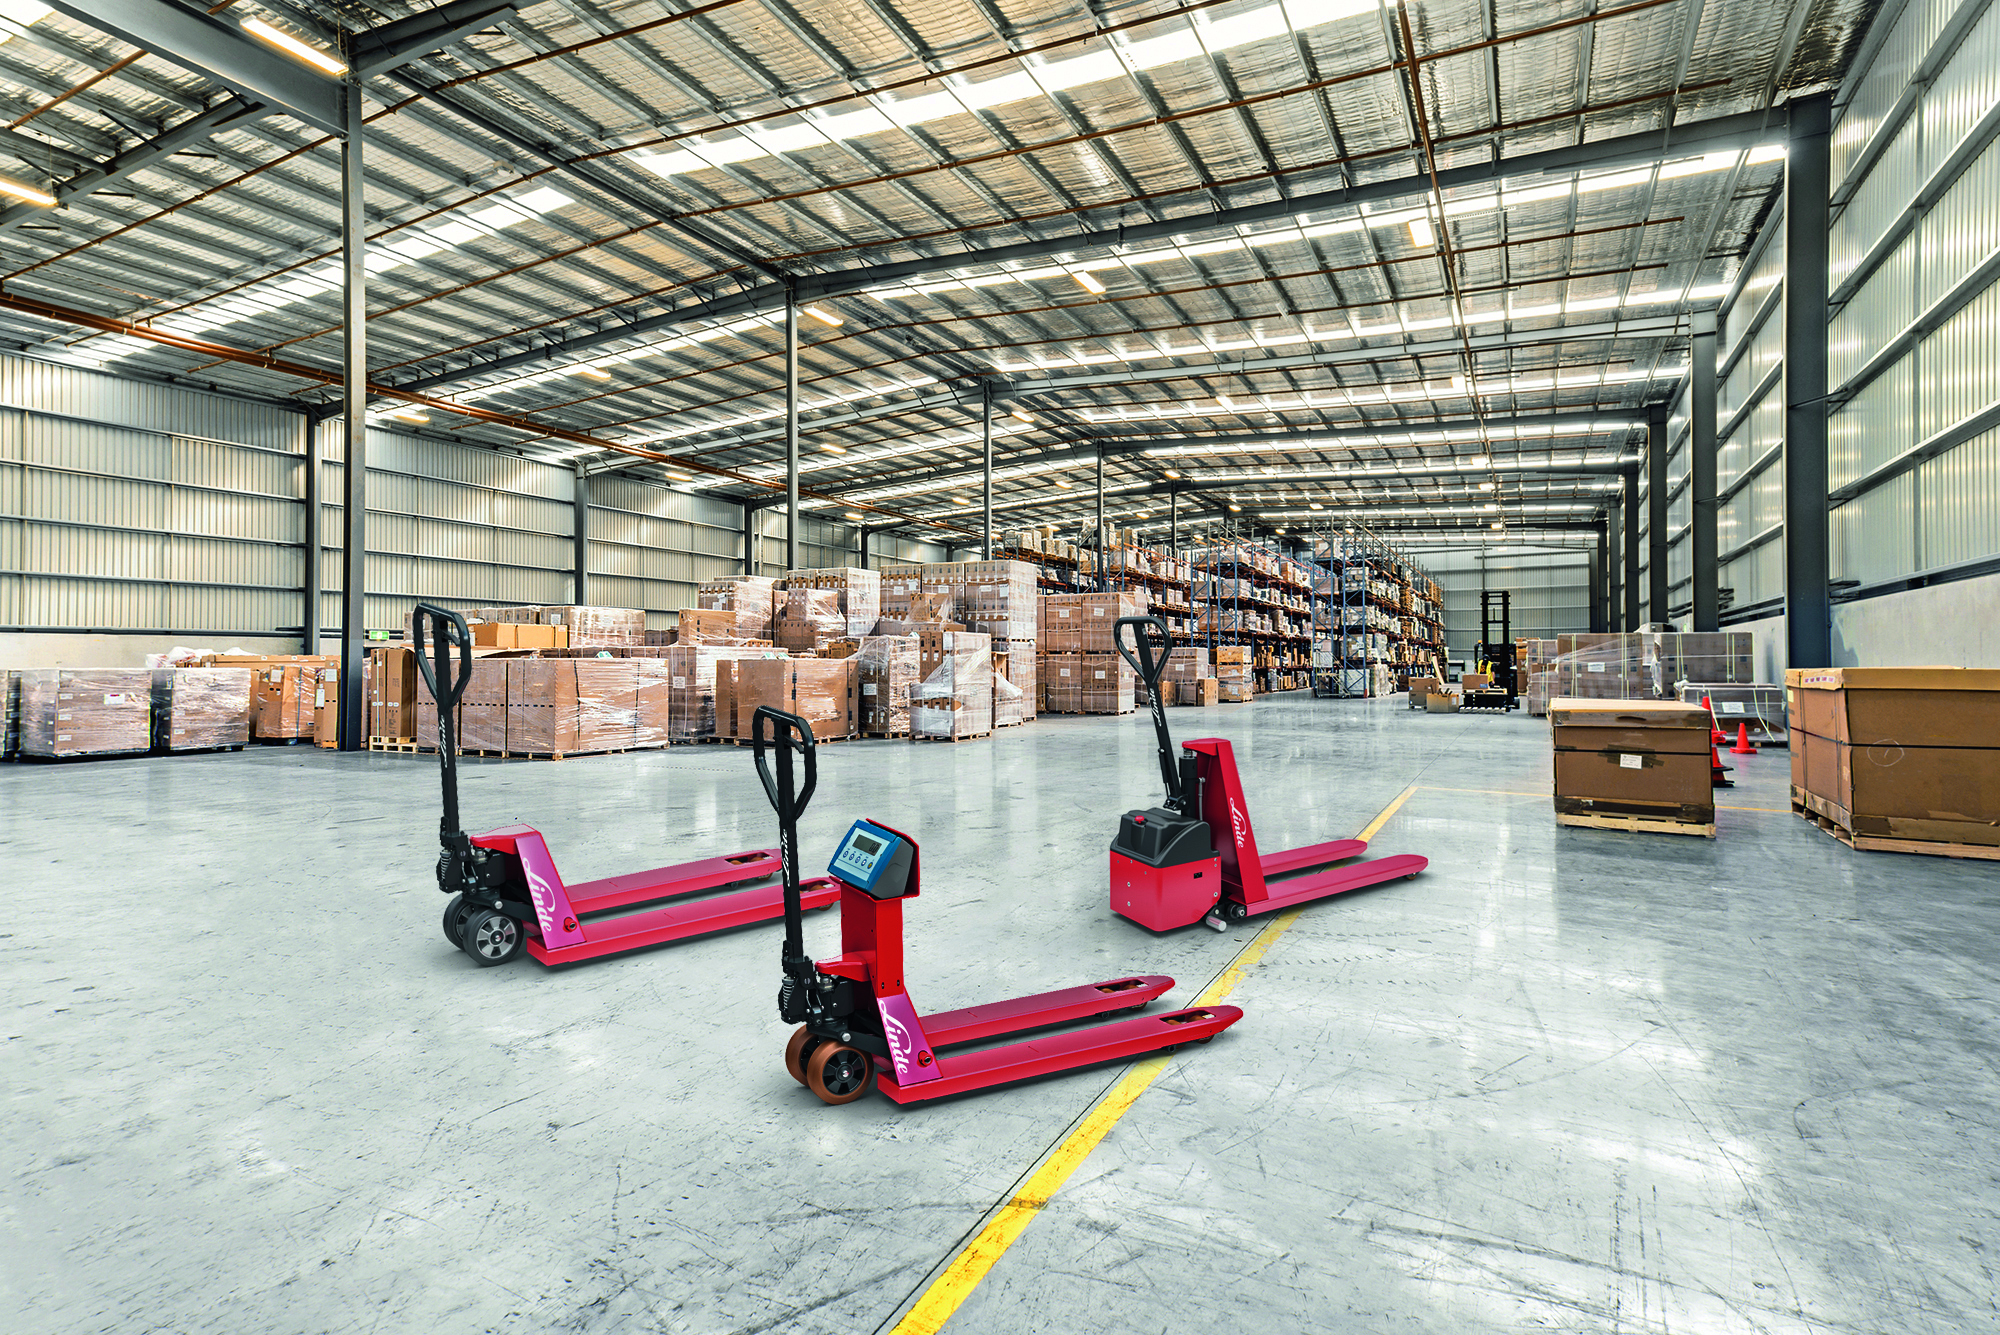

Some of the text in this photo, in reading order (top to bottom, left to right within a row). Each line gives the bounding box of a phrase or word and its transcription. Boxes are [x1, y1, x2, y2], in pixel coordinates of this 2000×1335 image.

[1149, 687, 1162, 727] Linde
[438, 714, 448, 769] Linde
[1229, 797, 1247, 848] Linde
[780, 828, 791, 888] Linde
[522, 857, 556, 933] Linde
[879, 999, 911, 1075] Linde
